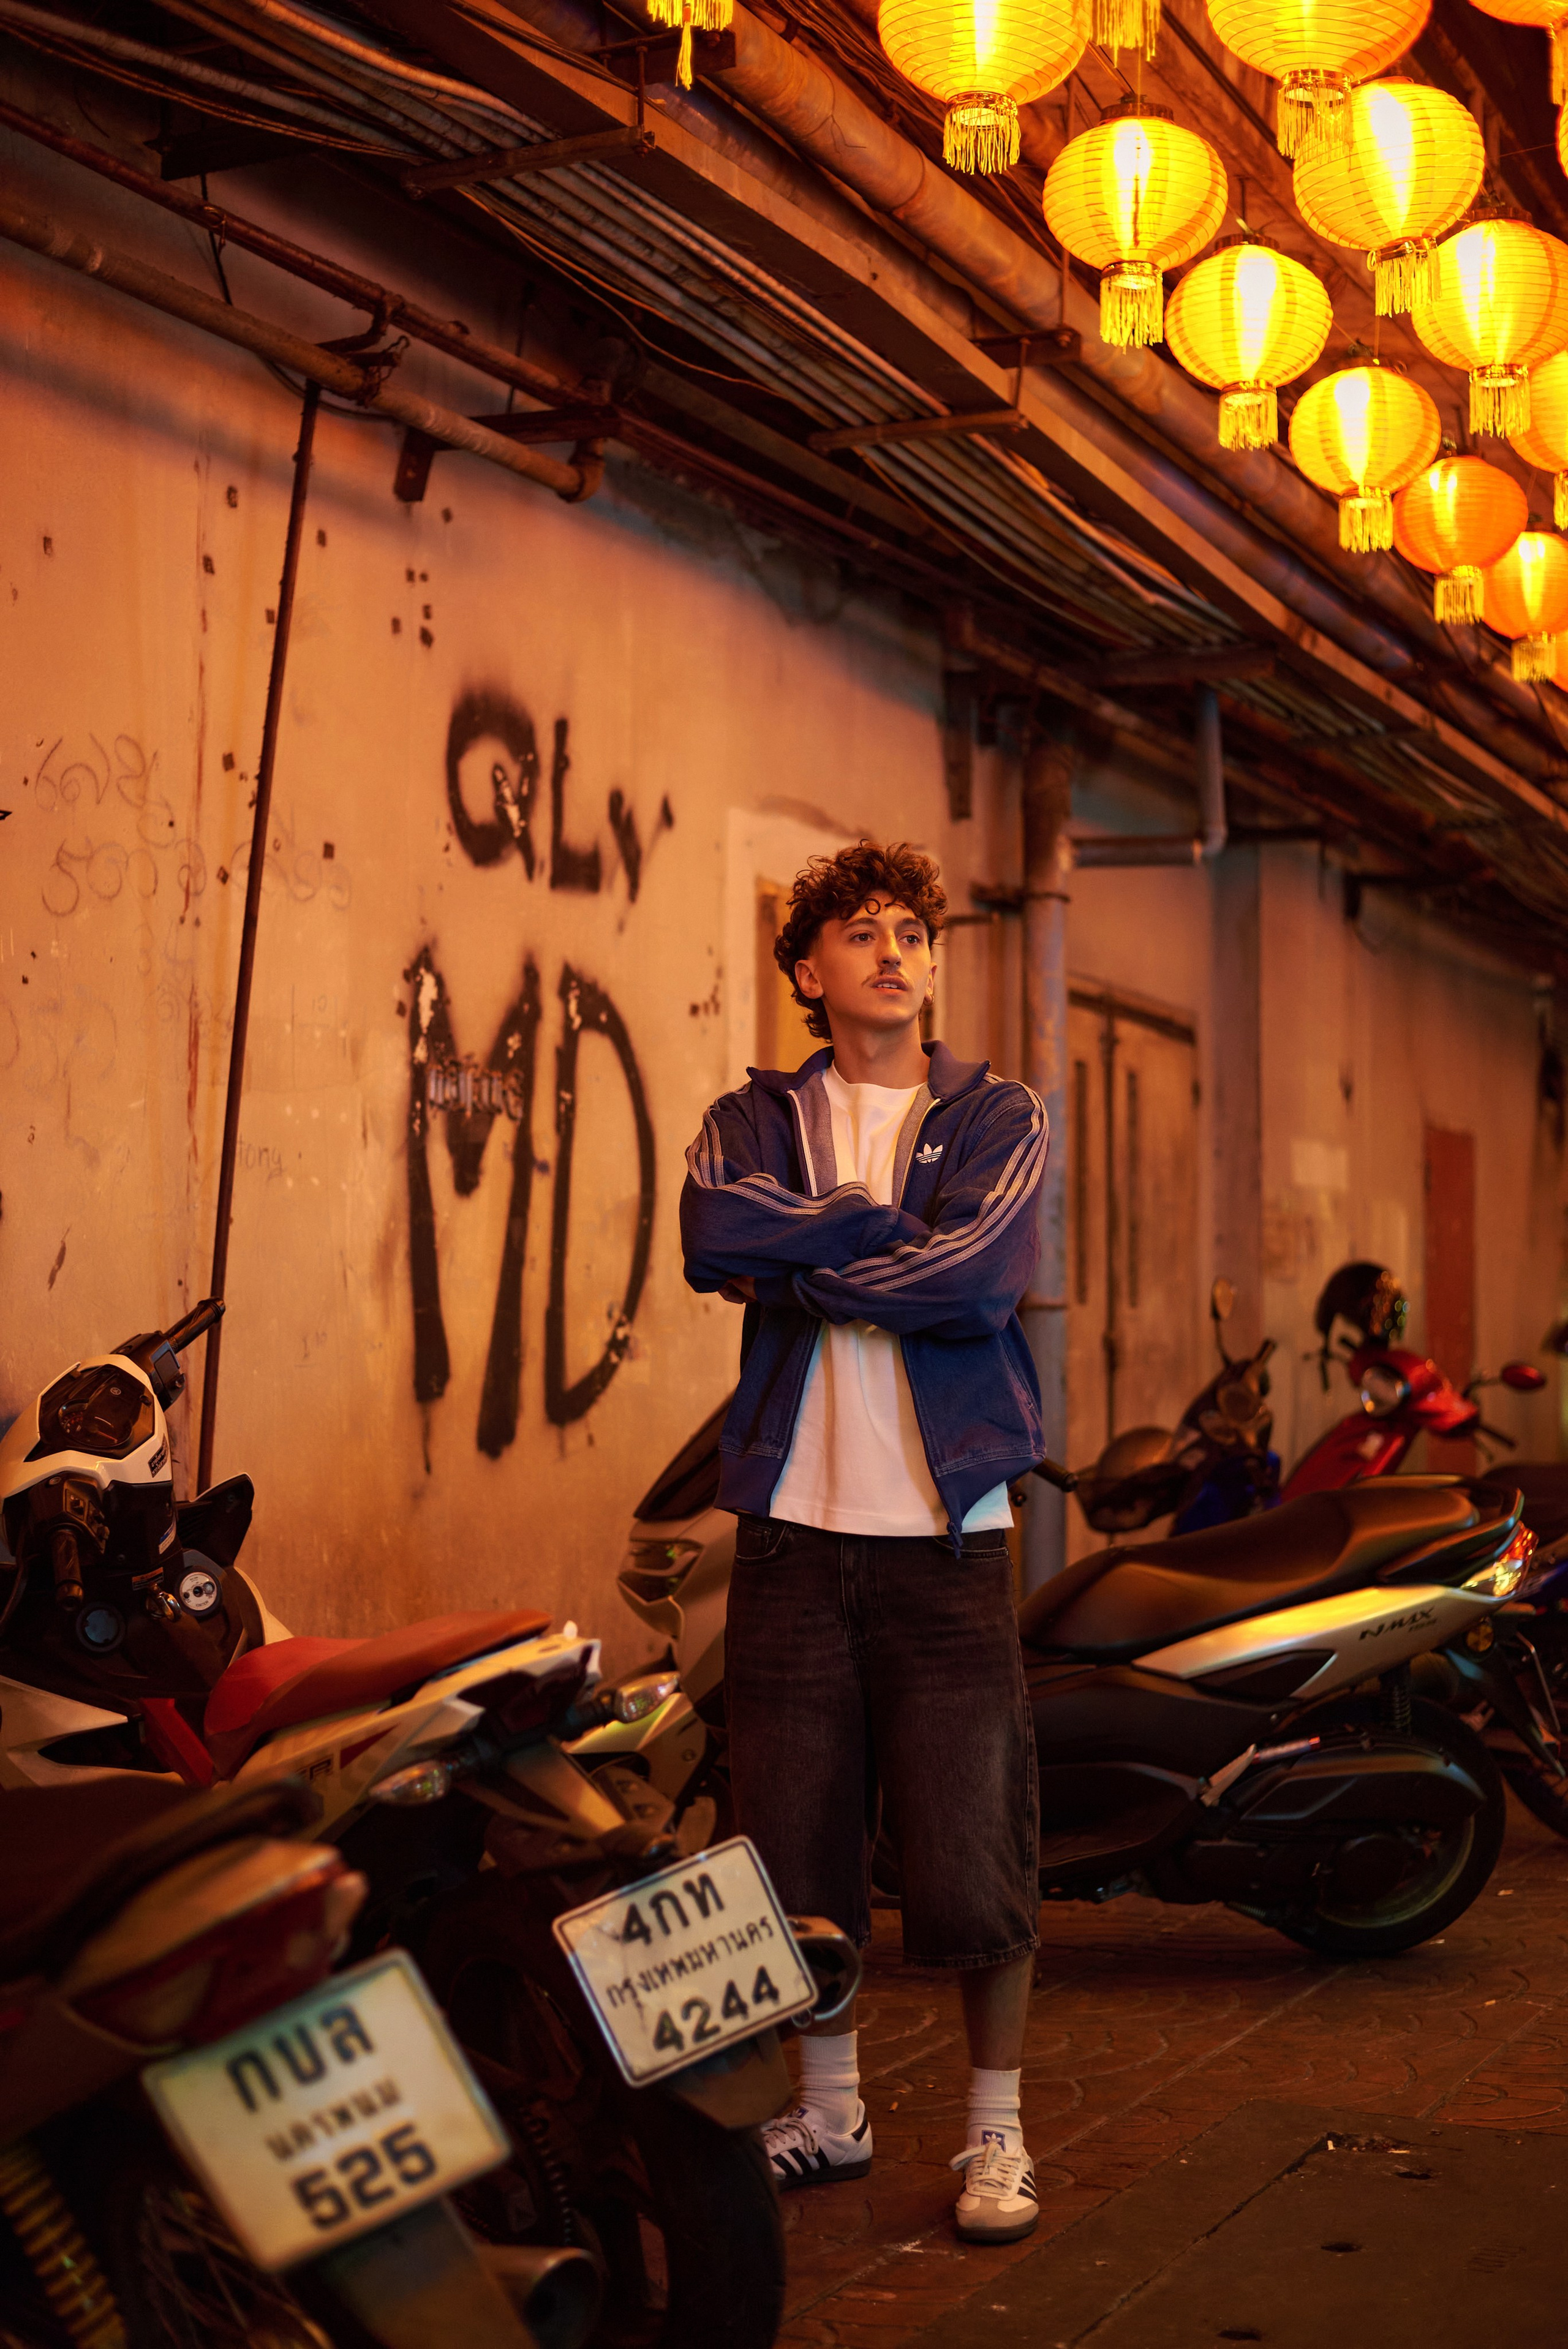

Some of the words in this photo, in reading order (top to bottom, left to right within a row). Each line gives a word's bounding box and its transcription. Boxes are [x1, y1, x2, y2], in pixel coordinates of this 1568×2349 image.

[1359, 1605, 1434, 1640] NMAX
[620, 1872, 725, 1948] 4กท
[606, 1915, 774, 2009] กรุงเทพมหานคร
[653, 1965, 780, 2053] 4244
[225, 2004, 374, 2114] กบล
[290, 2120, 437, 2231] 525
